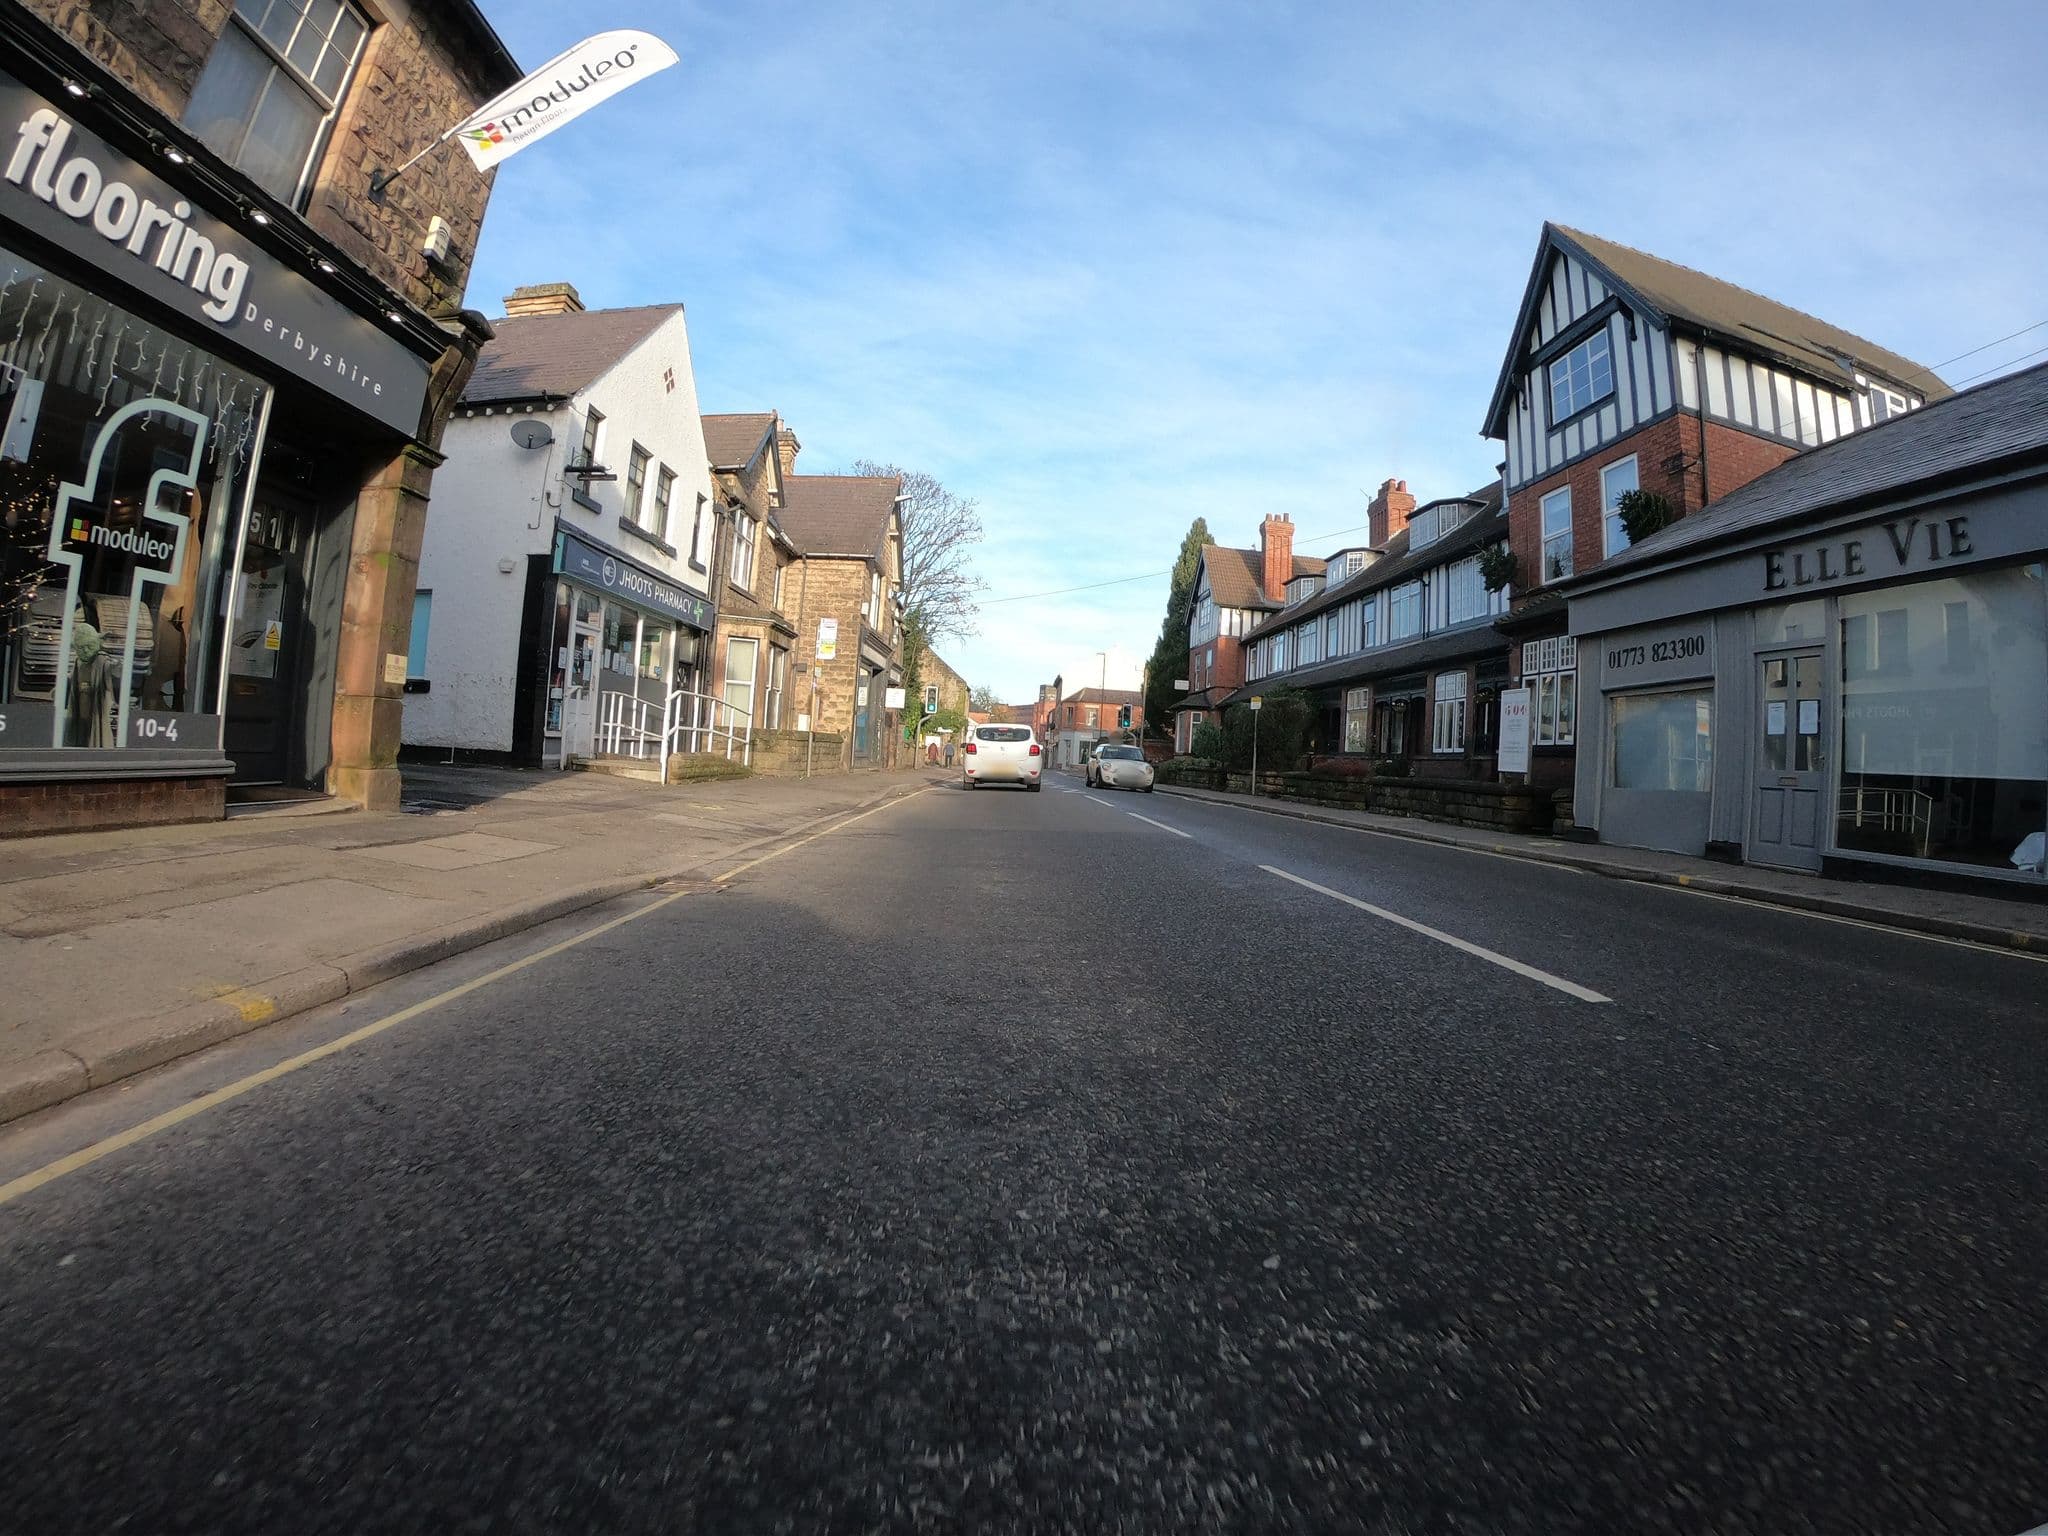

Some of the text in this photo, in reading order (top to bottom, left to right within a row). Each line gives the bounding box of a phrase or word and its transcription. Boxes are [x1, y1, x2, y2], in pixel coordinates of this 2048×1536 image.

[501, 48, 636, 134] moduleo
[5, 108, 383, 396] flooring Derbyshire
[90, 525, 170, 560] moduleo
[1762, 516, 1974, 592] ELLE VIE
[619, 569, 653, 598] JHOOTS
[654, 585, 693, 614] PHARMACY
[1608, 635, 1705, 669] 01773 823300
[136, 717, 178, 742] 10-4
